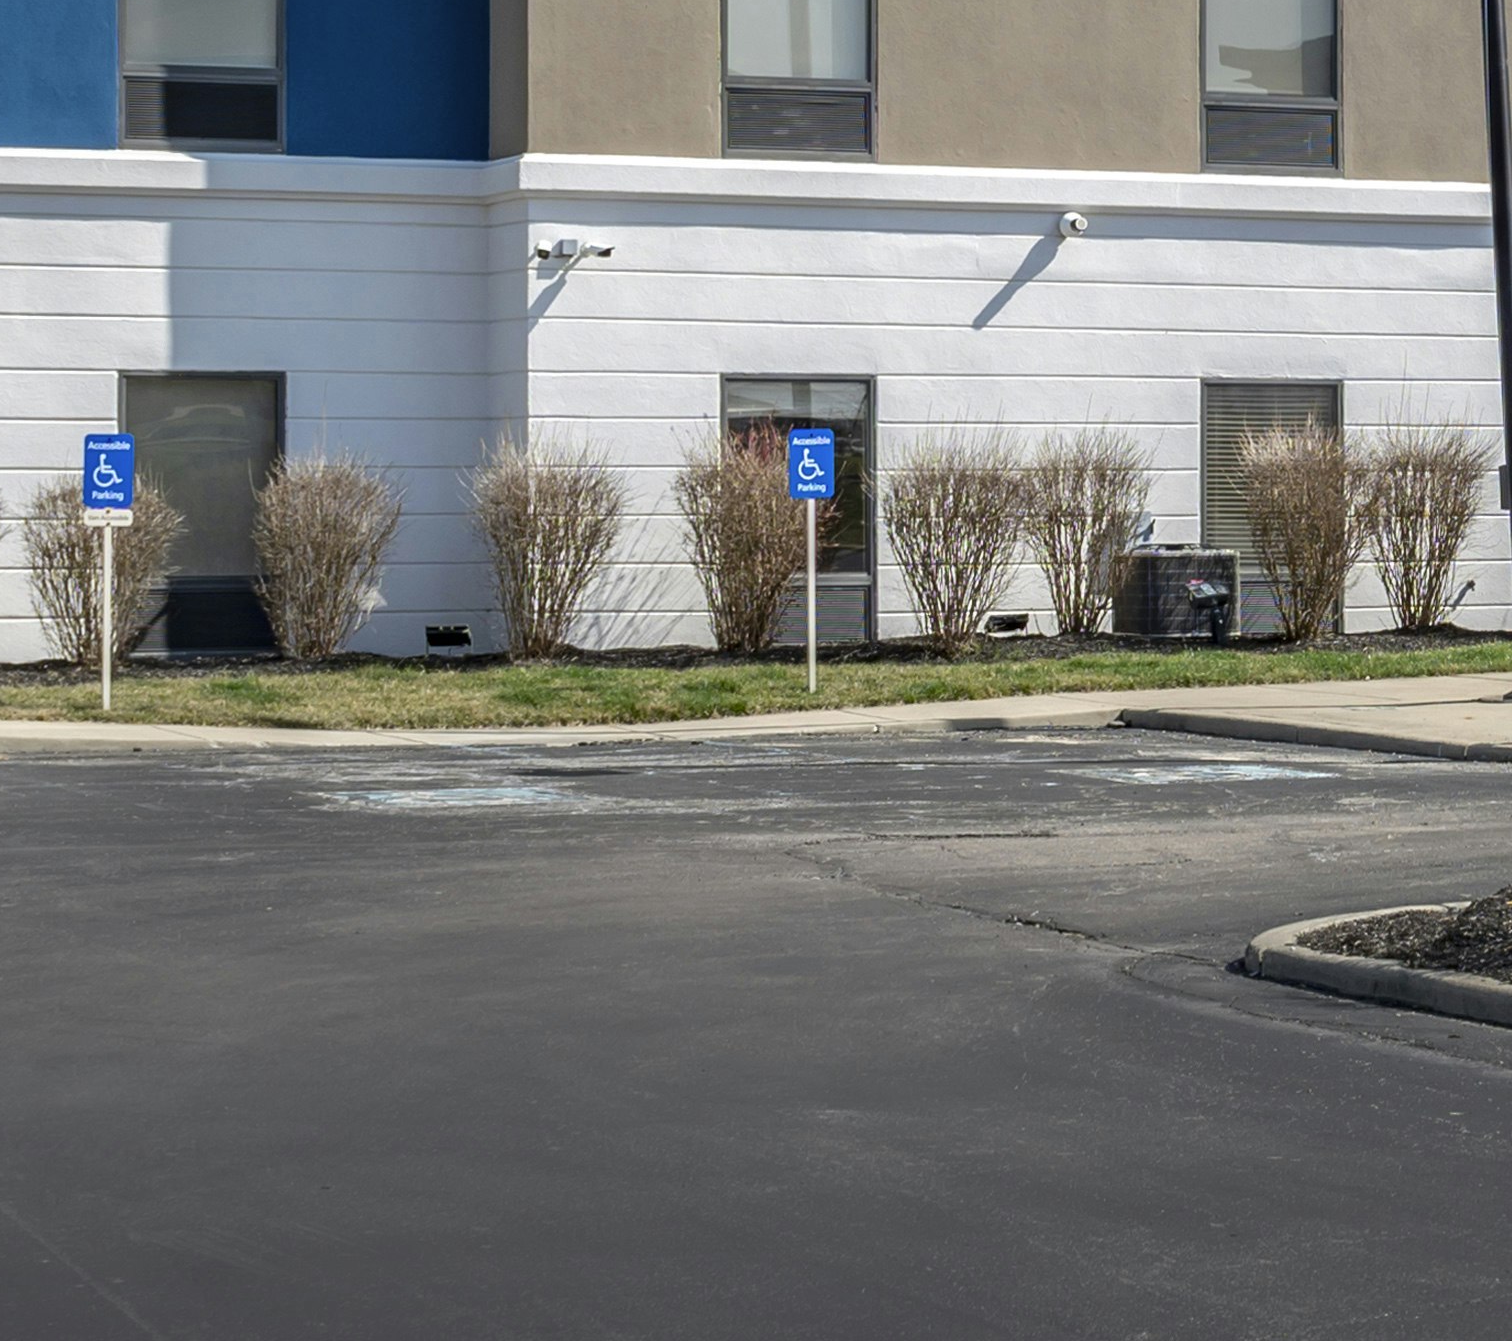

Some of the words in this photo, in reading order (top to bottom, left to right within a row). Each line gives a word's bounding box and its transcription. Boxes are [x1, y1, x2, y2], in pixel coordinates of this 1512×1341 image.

[87, 440, 131, 451] Accessible
[792, 435, 831, 446] Accessible
[797, 482, 826, 493] Parking
[92, 490, 124, 502] Parking
